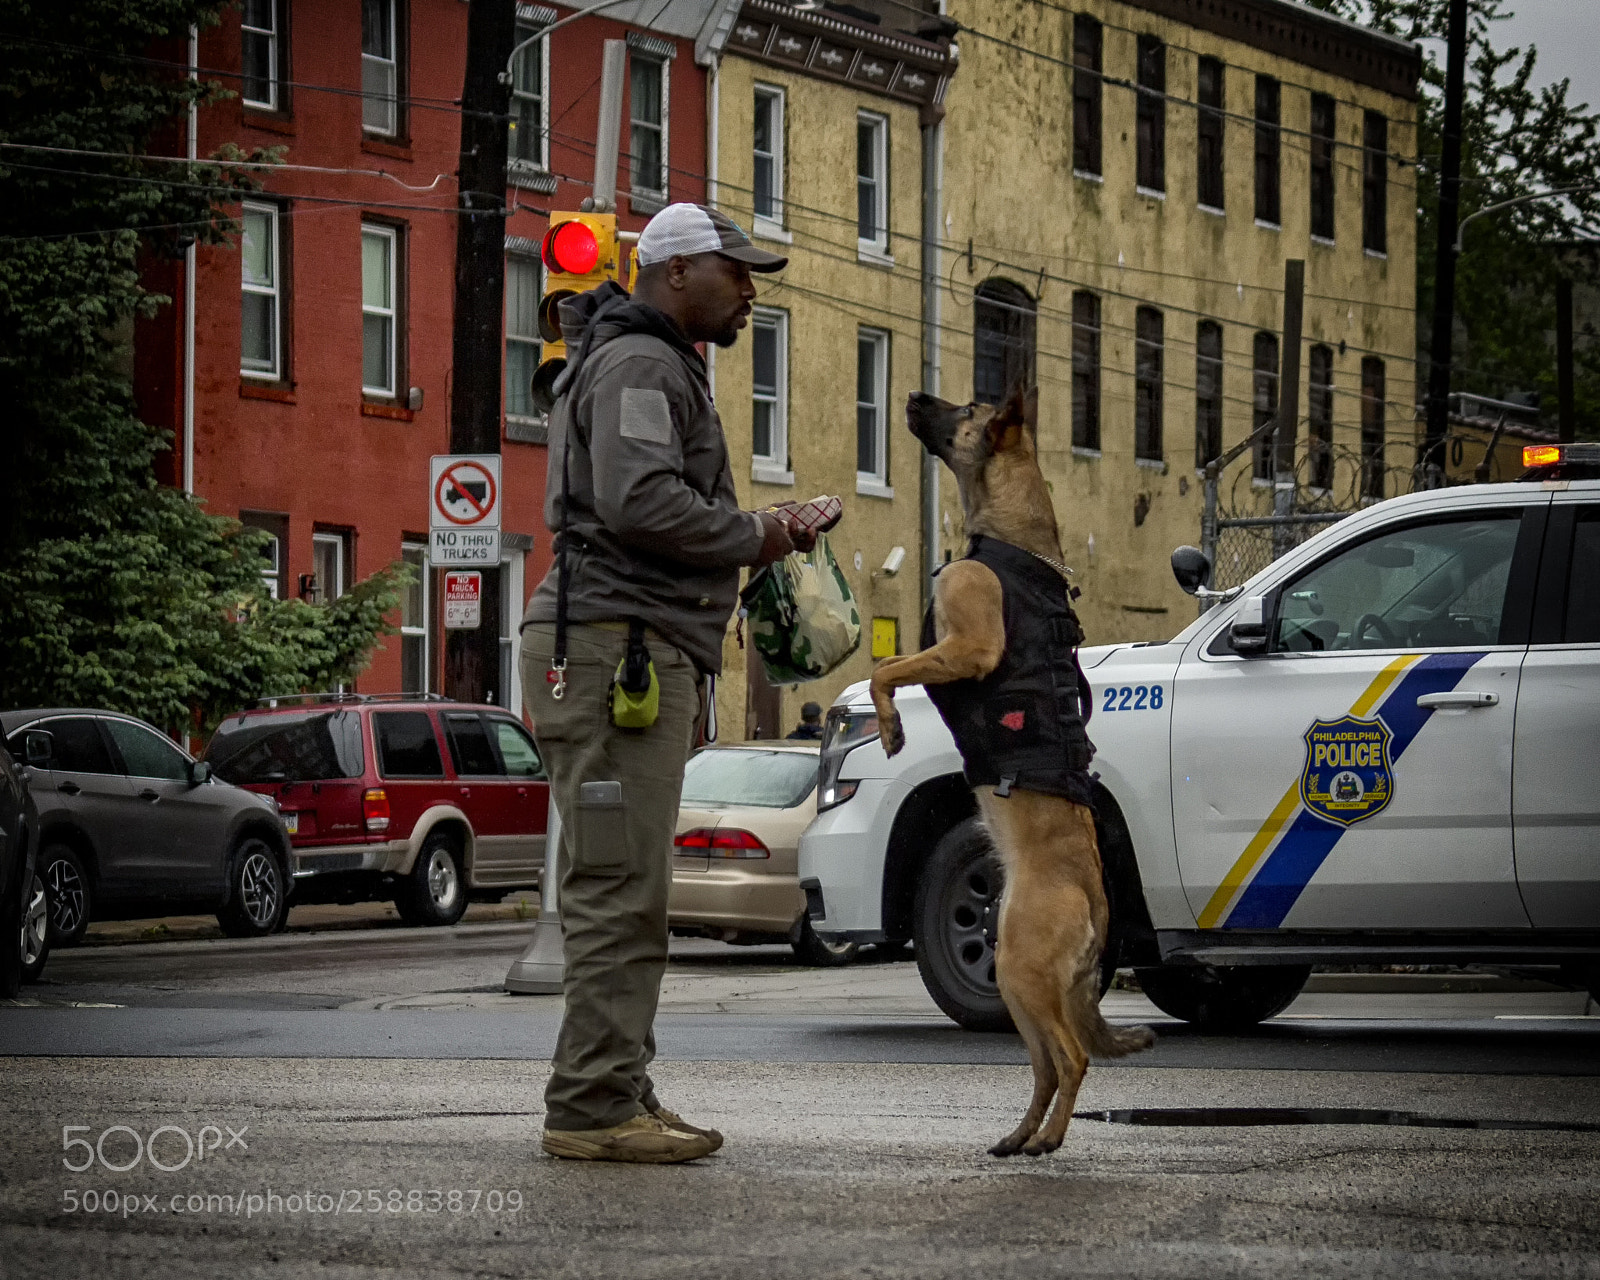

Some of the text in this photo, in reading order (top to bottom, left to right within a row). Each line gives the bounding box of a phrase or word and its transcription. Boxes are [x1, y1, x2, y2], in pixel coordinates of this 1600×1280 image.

[436, 532, 493, 546] NO THRU
[442, 548, 488, 559] TRUCKS
[457, 576, 469, 584] NO
[451, 584, 474, 592] TRUCK
[447, 592, 478, 600] PARKING
[1102, 685, 1163, 712] 2228
[1313, 732, 1381, 741] PHILADELPHIA
[1315, 743, 1381, 767] POLICE
